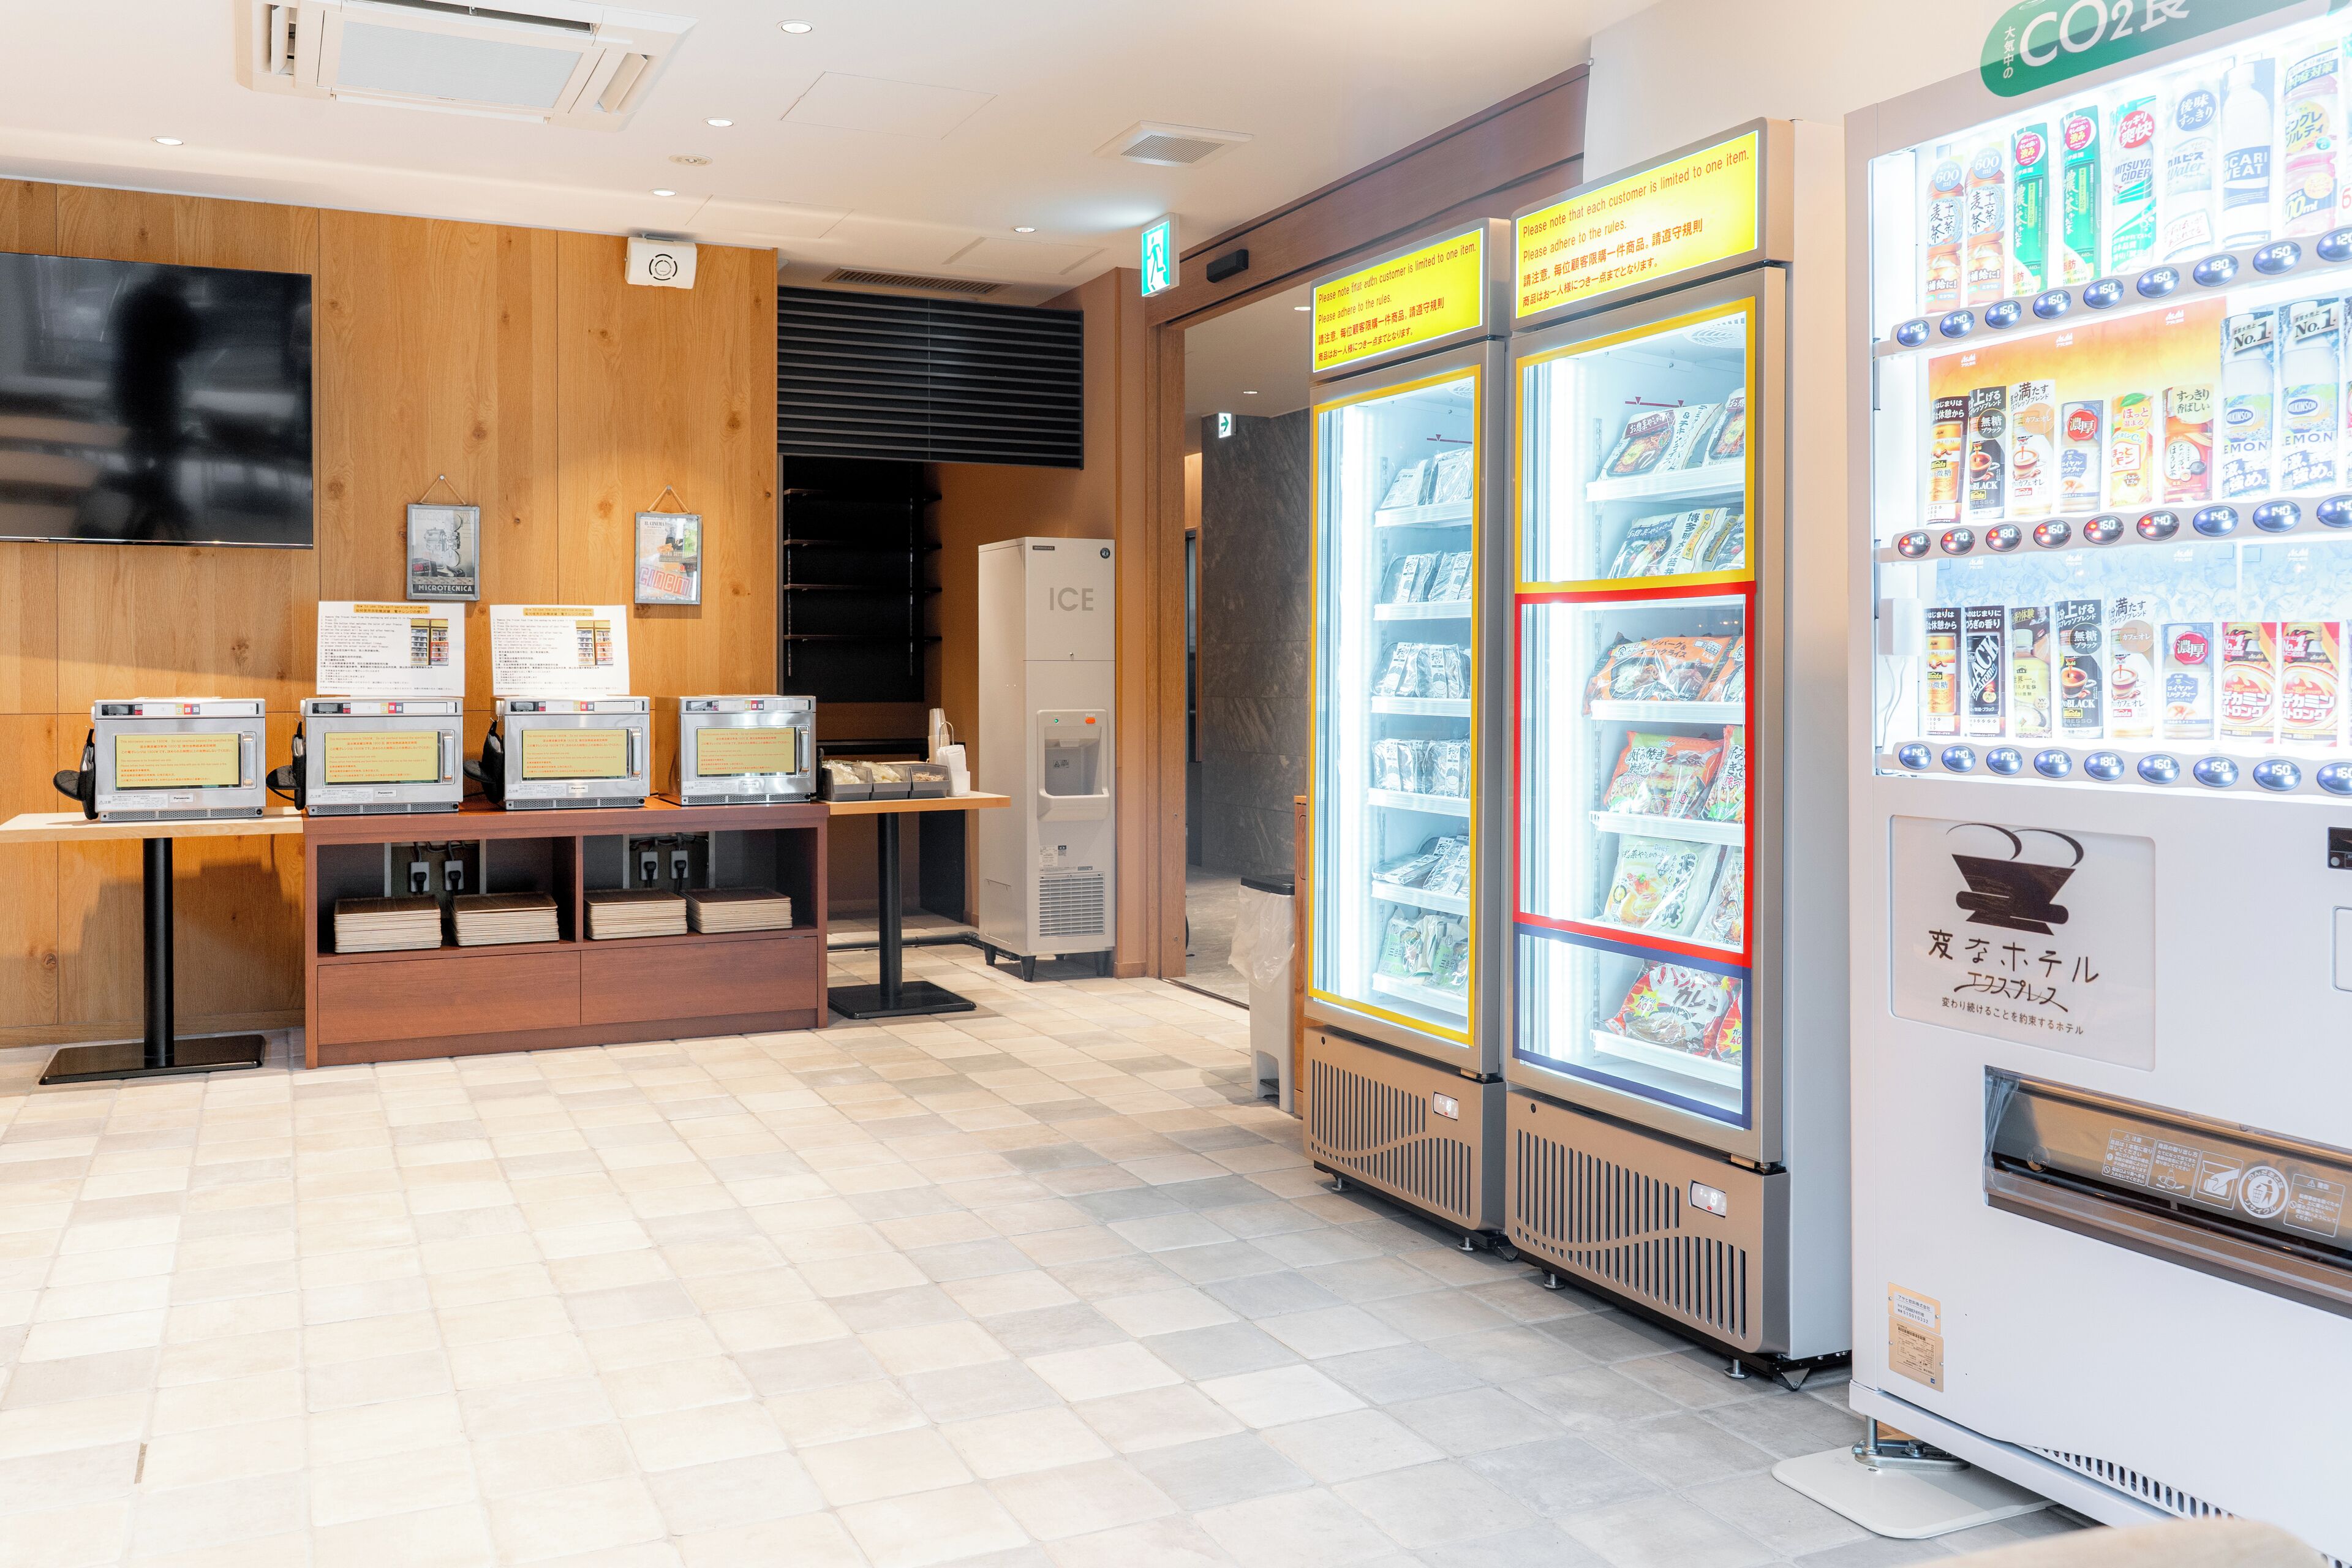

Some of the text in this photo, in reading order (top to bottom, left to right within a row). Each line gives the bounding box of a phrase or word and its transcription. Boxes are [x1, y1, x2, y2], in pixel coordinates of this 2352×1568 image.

[2003, 26, 2016, 79] 大気中の
[2180, 93, 2209, 116] 後味
[2118, 111, 2146, 132] スッキリ
[2179, 107, 2213, 129] すっきり
[2121, 124, 2153, 148] 爽快
[1975, 155, 1999, 170] 600
[2114, 158, 2152, 176] MITSUYA
[1935, 168, 1959, 181] 600
[2121, 168, 2152, 183] CIDER
[1523, 148, 1749, 238] Please note that each customer is limited to one item.
[1970, 191, 1986, 232] 麦茶
[1985, 191, 1997, 222] 十六茶
[1931, 203, 1945, 243] 麦茶
[1944, 203, 1954, 234] 十六茶
[1523, 218, 1627, 263] Please adhere to the rules.
[2271, 246, 2291, 257] 150
[2211, 259, 2229, 271] 180
[1318, 287, 1336, 304] Please
[1338, 285, 1349, 298] note
[1379, 268, 1406, 285] customer
[1408, 263, 1414, 274] is
[1415, 255, 1436, 271] limited
[1437, 253, 1444, 263] to
[1446, 249, 1458, 260] one
[1460, 242, 1477, 256] item.
[2153, 271, 2171, 283] 160
[1523, 257, 1659, 308] 商品はお一人様につき一点までとなります。
[2099, 283, 2115, 293] 160
[2048, 294, 2062, 304] 160
[1318, 293, 1392, 325] Please adhere to the rules.
[1999, 304, 2014, 315] 160
[1953, 314, 1967, 324] 140
[2294, 307, 2334, 339] No.1
[1910, 323, 1923, 333] 140
[2233, 319, 2269, 350] No.1
[1318, 326, 1413, 362] 商品はお一人様につき一点までとなります。
[2176, 389, 2210, 401] すっきり
[2122, 407, 2149, 420] ほっと
[2176, 402, 2211, 415] 香ばしい
[1981, 415, 2002, 428] 無糖
[2024, 415, 2052, 423] カフェオレ
[1981, 425, 2002, 434] ブラック
[2069, 417, 2095, 435] 濃厚
[2292, 463, 2333, 485] 強め。
[2228, 470, 2267, 492] 強め。
[2211, 510, 2229, 521] 140
[2271, 505, 2291, 516] 140
[2100, 519, 2116, 530] 160
[2153, 516, 2170, 526] 140
[2000, 529, 2014, 538] 180
[2048, 524, 2064, 534] 160
[1909, 535, 1924, 546] 140
[1954, 532, 1968, 541] 170
[1050, 587, 1093, 611] ICE
[2074, 630, 2098, 642] 無糖
[2121, 632, 2151, 641] カフェオレ
[2176, 640, 2205, 658] 濃厚
[1910, 747, 1926, 758] 140
[1953, 749, 1969, 759] 140
[2000, 752, 2016, 763] 170
[2048, 753, 2065, 764] 170
[2098, 756, 2116, 769] 180
[2153, 759, 2171, 771] 160
[2210, 761, 2230, 773] 150
[2271, 764, 2291, 776] 150
[1928, 929, 2100, 984] 変なホテル
[1954, 971, 2068, 1012] エクスプレス
[1941, 997, 2084, 1035] 変わり続けることを約束するホテル
[2247, 1170, 2285, 1190] のんだあとは
[2244, 1198, 2277, 1215] リサイクル
